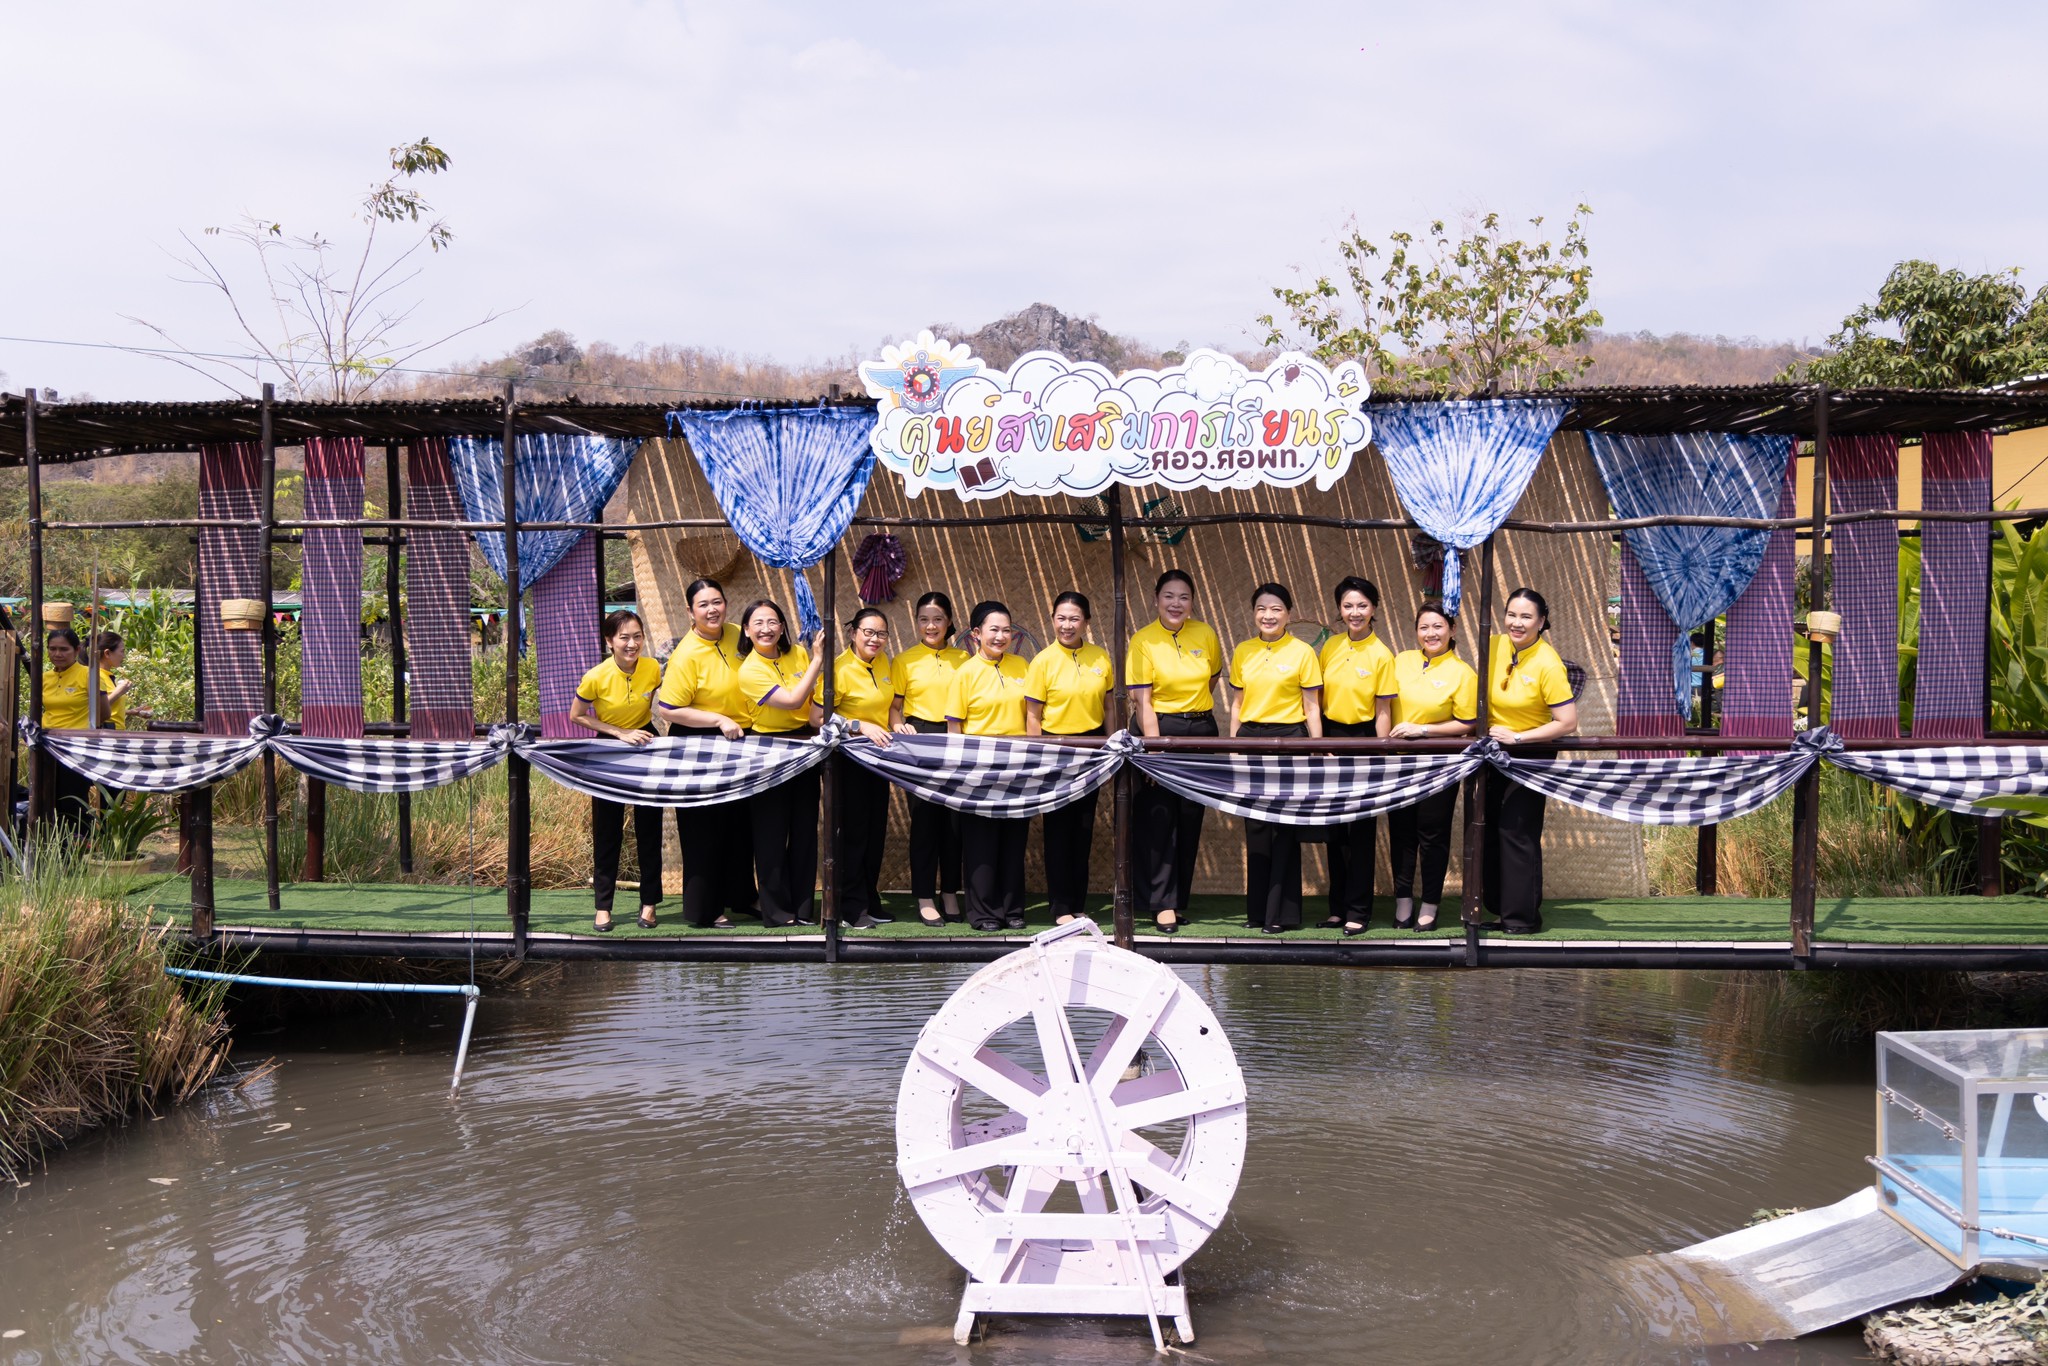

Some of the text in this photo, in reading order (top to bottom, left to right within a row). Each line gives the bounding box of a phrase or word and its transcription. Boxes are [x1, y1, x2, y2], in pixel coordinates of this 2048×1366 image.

[900, 382, 1358, 477] ศูนย์ส่งเสริมการเรียนรู้
[1151, 449, 1305, 471] ศอว.ศอพท.
